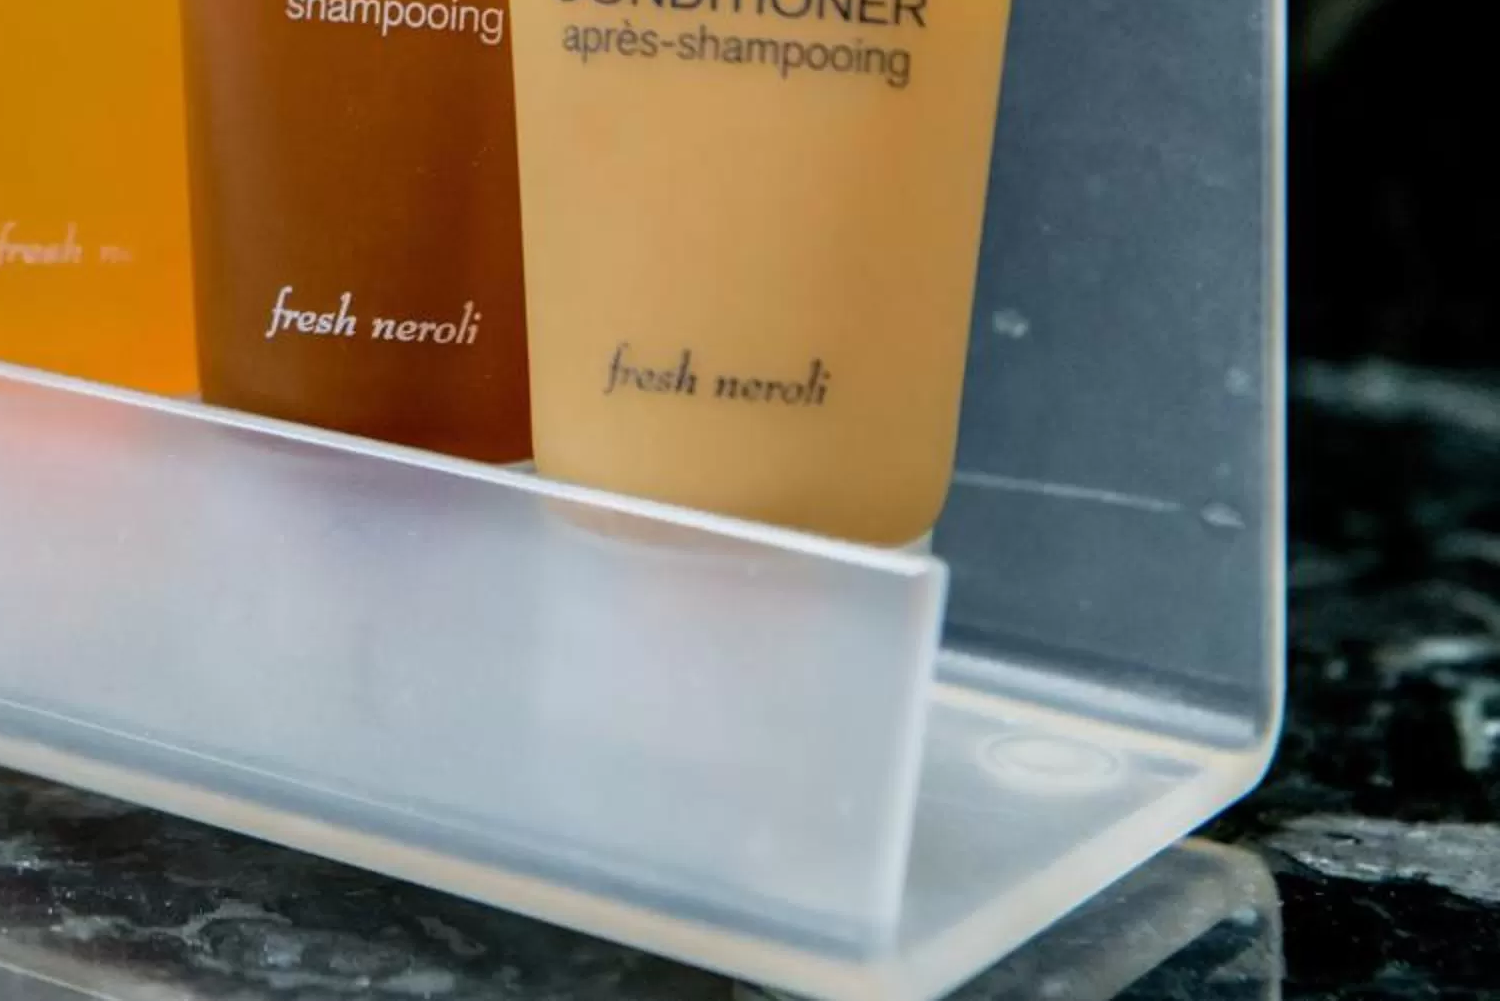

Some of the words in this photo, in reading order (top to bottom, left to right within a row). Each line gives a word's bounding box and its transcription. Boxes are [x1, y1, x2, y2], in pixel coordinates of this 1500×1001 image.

[562, 19, 912, 89] après-shampooing
[266, 286, 357, 339] fresh
[371, 301, 482, 345] neroli
[603, 343, 698, 396] fresh
[713, 358, 831, 407] neroli
